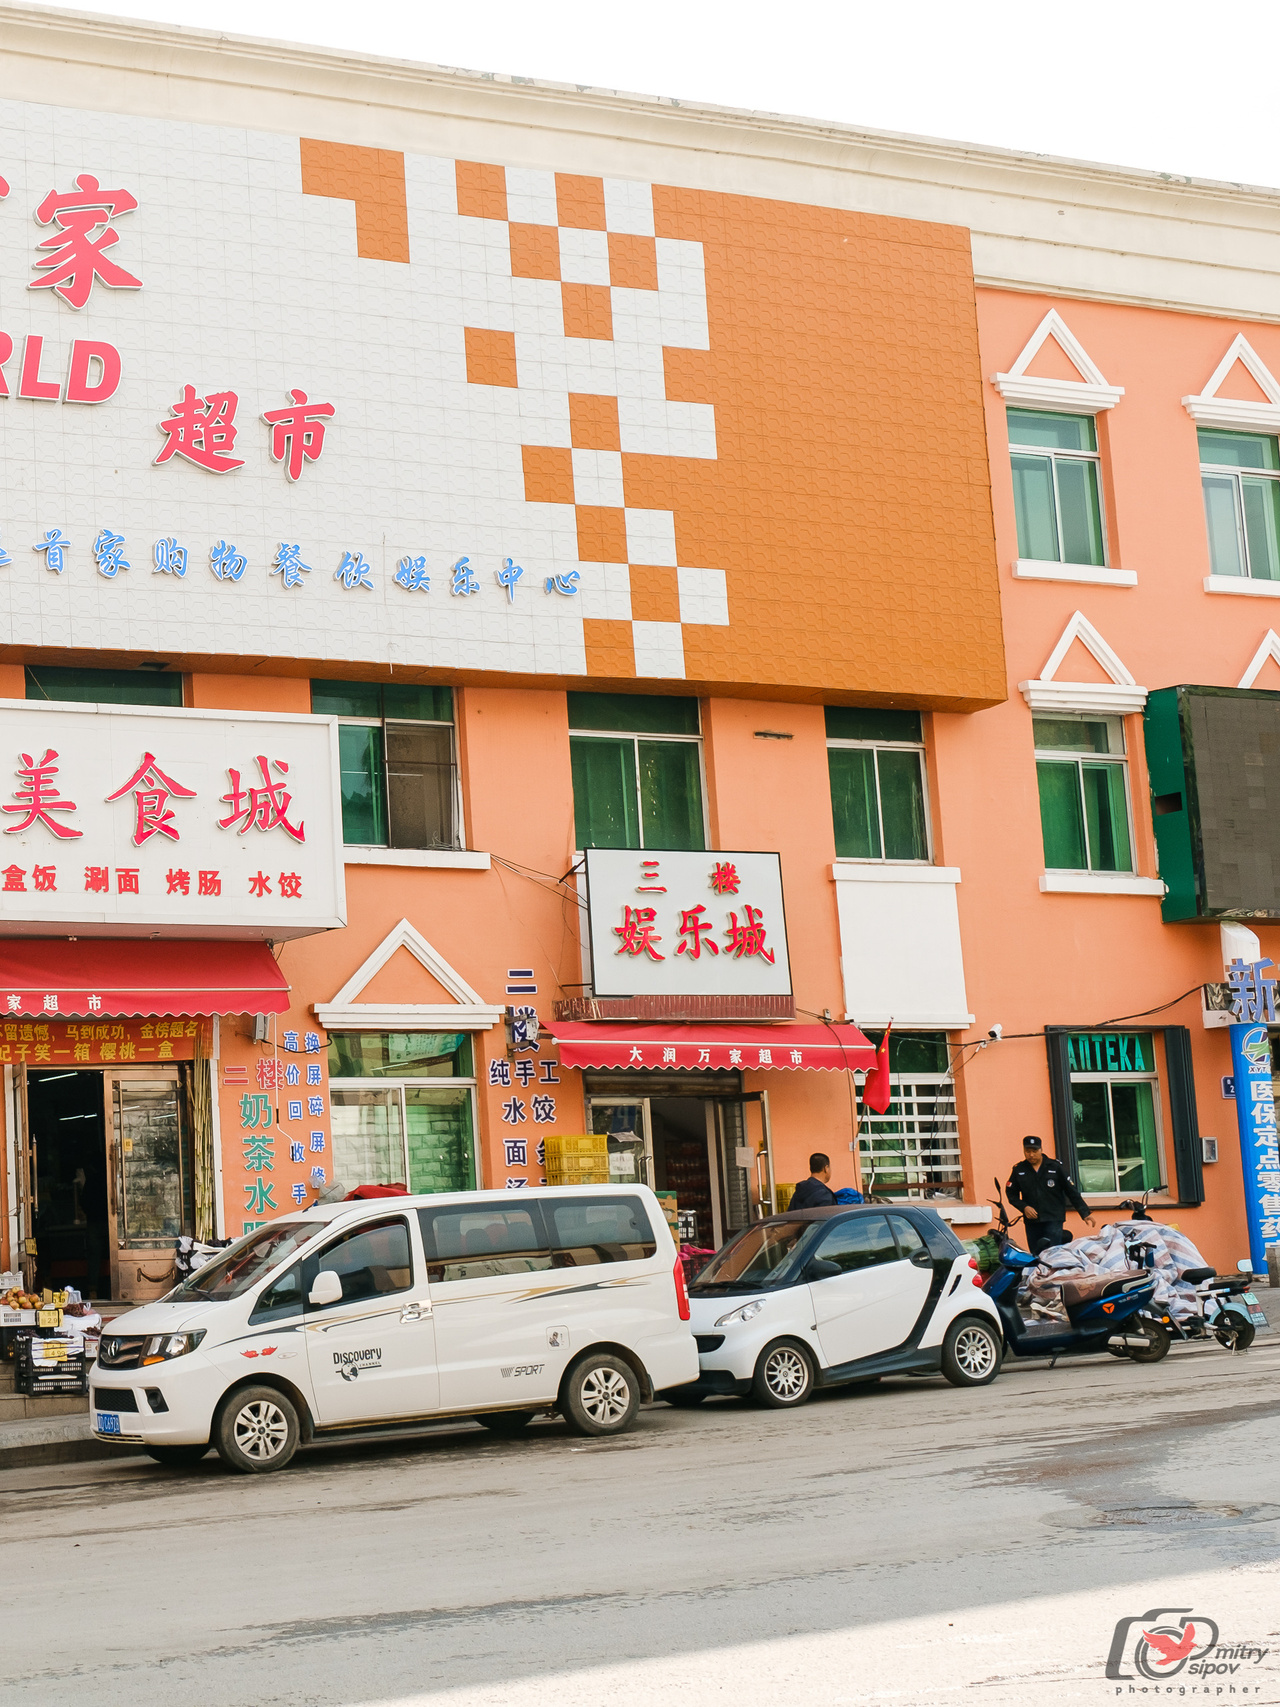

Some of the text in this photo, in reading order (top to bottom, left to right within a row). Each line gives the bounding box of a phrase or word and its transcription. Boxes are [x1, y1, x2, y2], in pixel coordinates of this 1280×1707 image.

[153, 382, 337, 482] 超市
[84, 864, 141, 896] 涮面
[165, 868, 222, 898] 烤肠
[247, 870, 304, 900] 水饺
[636, 859, 742, 896] 三楼
[612, 903, 776, 965] 娱乐城
[100, 1040, 174, 1061] 樱桃一盒
[629, 1045, 803, 1067] 大润万家超市
[223, 1058, 284, 1091] 二楼
[488, 1058, 562, 1088] 纯手工
[501, 1094, 557, 1126] 水饺
[1250, 1080, 1280, 1262] 医保定点零售药
[513, 1364, 546, 1378] SPORT
